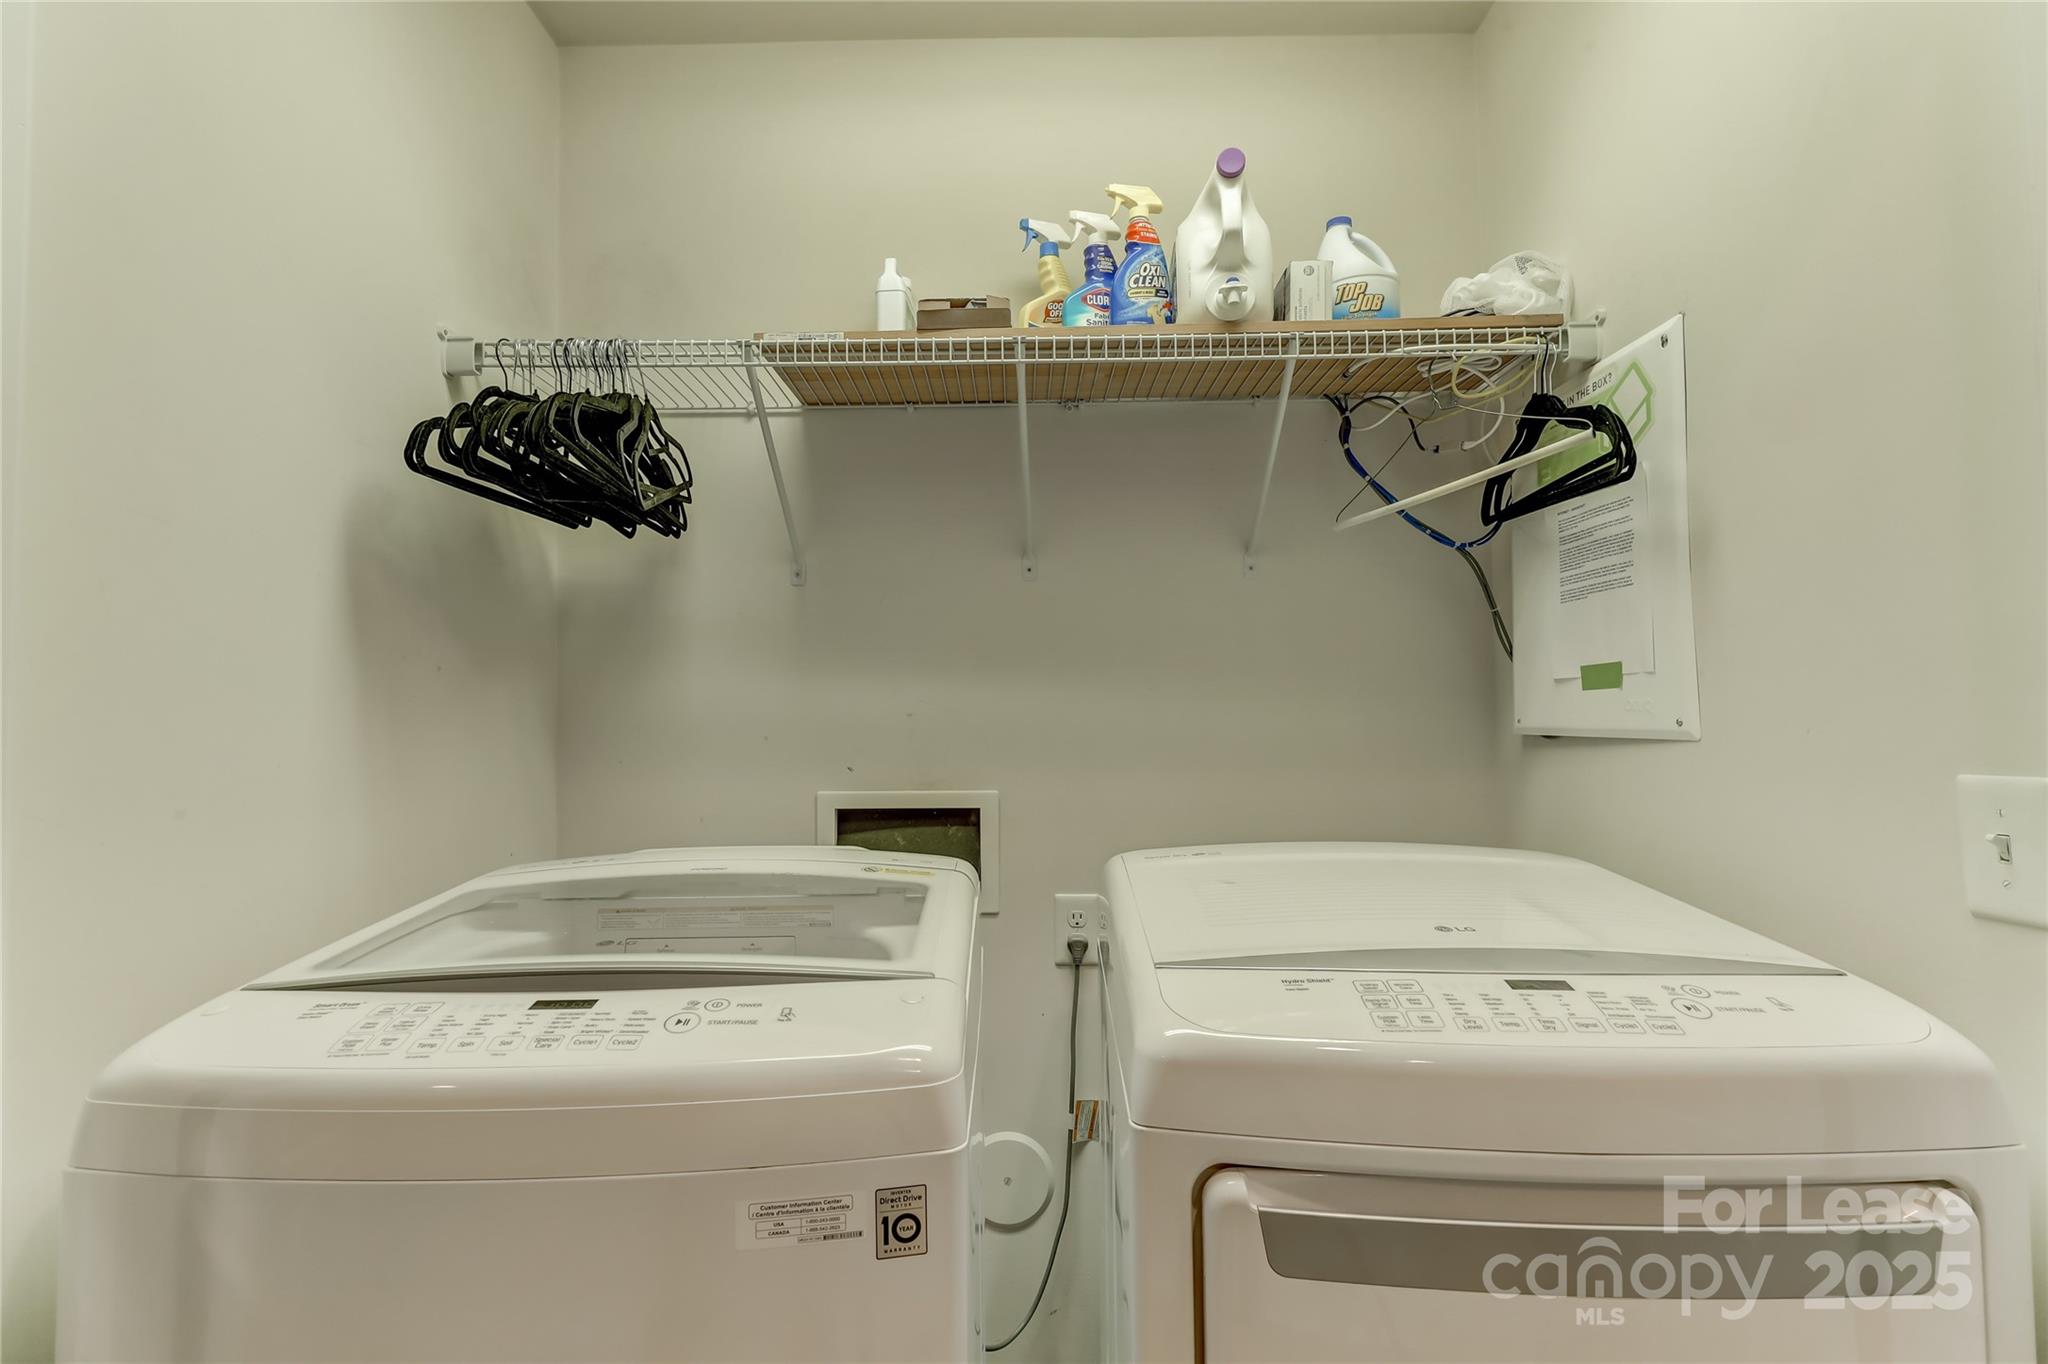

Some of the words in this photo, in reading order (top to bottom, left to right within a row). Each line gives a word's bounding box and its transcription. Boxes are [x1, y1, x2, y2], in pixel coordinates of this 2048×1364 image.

[1140, 262, 1161, 276] OXI
[1129, 273, 1166, 288] CLEAN
[1334, 281, 1368, 306] TOP
[1087, 294, 1110, 306] CLOR
[1349, 293, 1385, 314] JOB
[1566, 394, 1575, 407] IN
[1576, 384, 1591, 401] THE
[1591, 371, 1613, 393] BOX?
[573, 1039, 598, 1047] Cycle1
[612, 1039, 638, 1047] Cycle2
[760, 1203, 788, 1212] Customer
[789, 1200, 822, 1209] Information
[823, 1198, 842, 1206] Center
[880, 1196, 902, 1205] Direct
[903, 1194, 922, 1203] Drive
[755, 1210, 775, 1218] Centre
[767, 1229, 790, 1237] CANADA
[881, 1212, 922, 1246] 10
[899, 1225, 914, 1233] YEAR
[884, 1245, 921, 1254] WARRANTY
